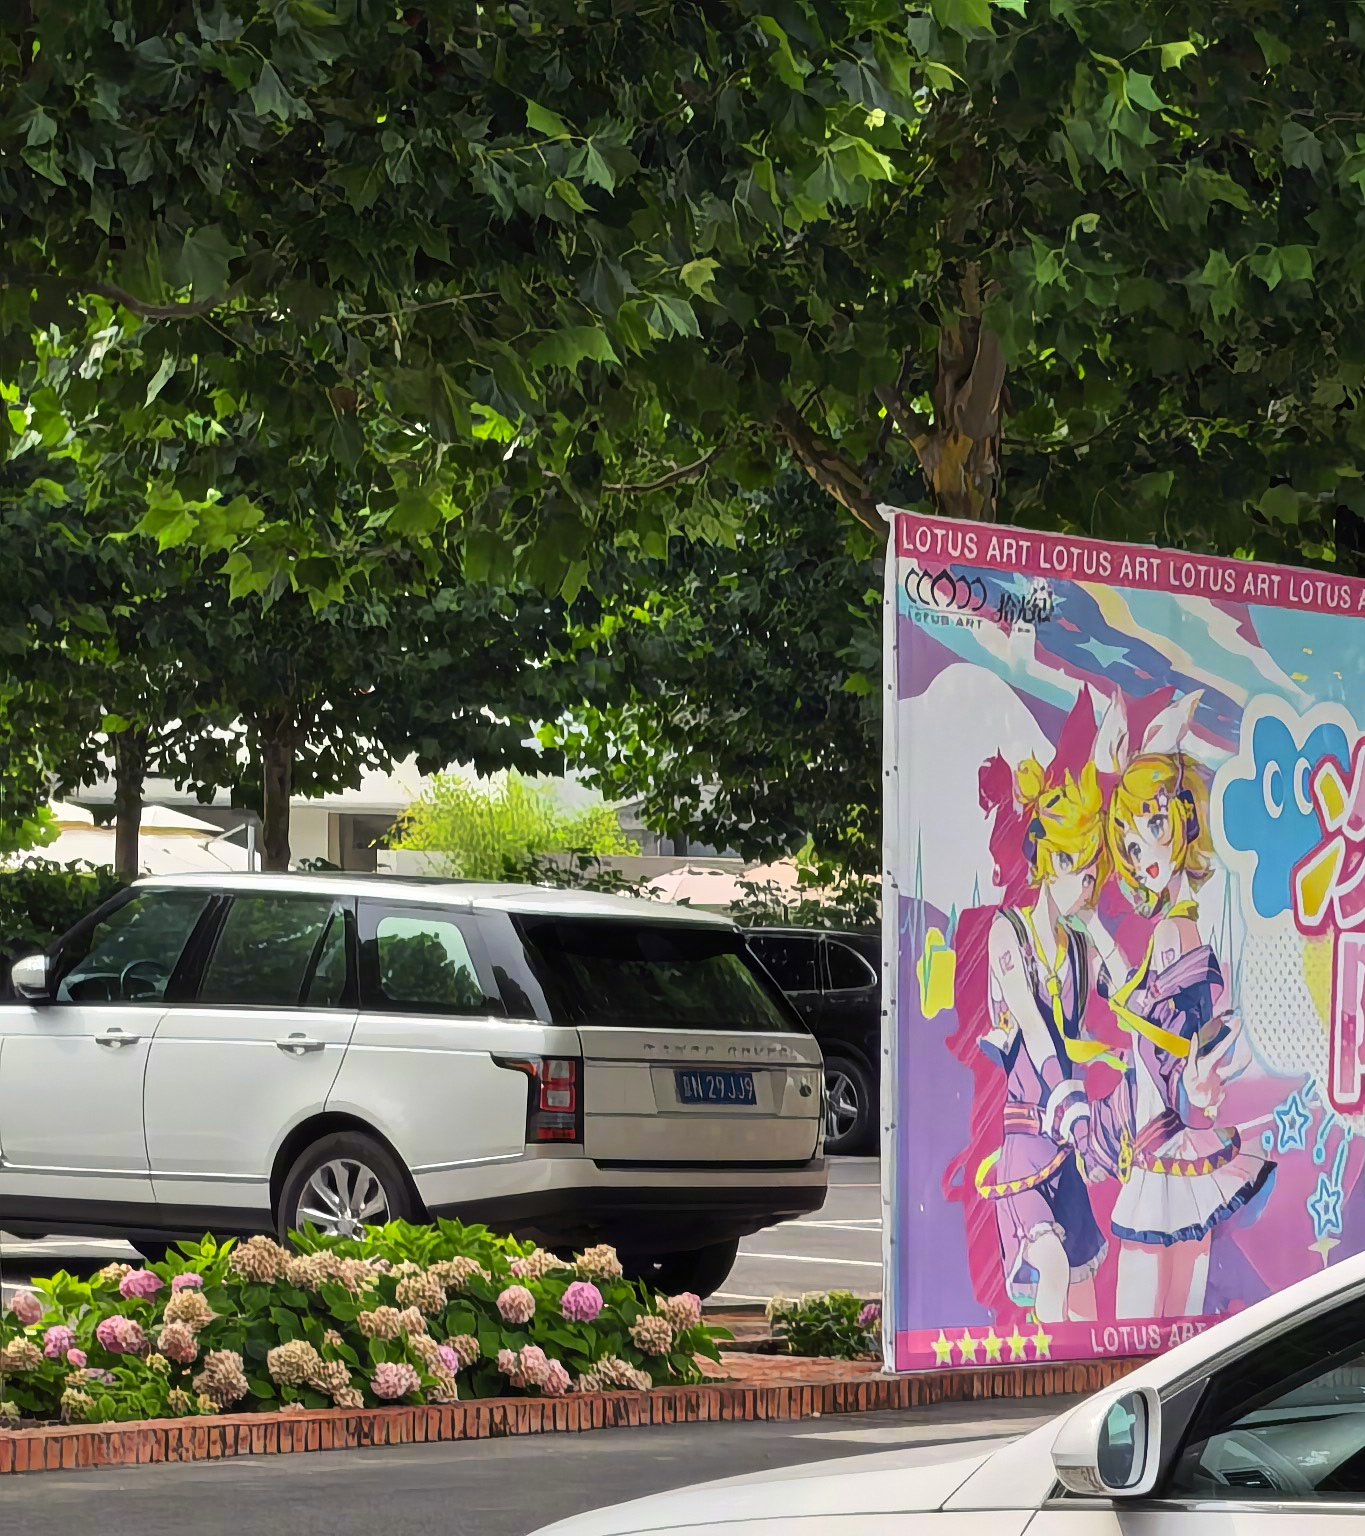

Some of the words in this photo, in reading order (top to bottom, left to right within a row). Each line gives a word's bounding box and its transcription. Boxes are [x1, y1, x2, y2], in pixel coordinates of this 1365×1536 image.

[902, 521, 978, 560] LOTUS
[986, 535, 1031, 566] ART
[1039, 543, 1111, 577] LOTUS
[1119, 553, 1161, 583] ART
[1169, 560, 1236, 593] LOTUS
[1242, 572, 1282, 600] ART
[1289, 578, 1351, 609] LOTUS
[1090, 1324, 1161, 1353] LOTUS
